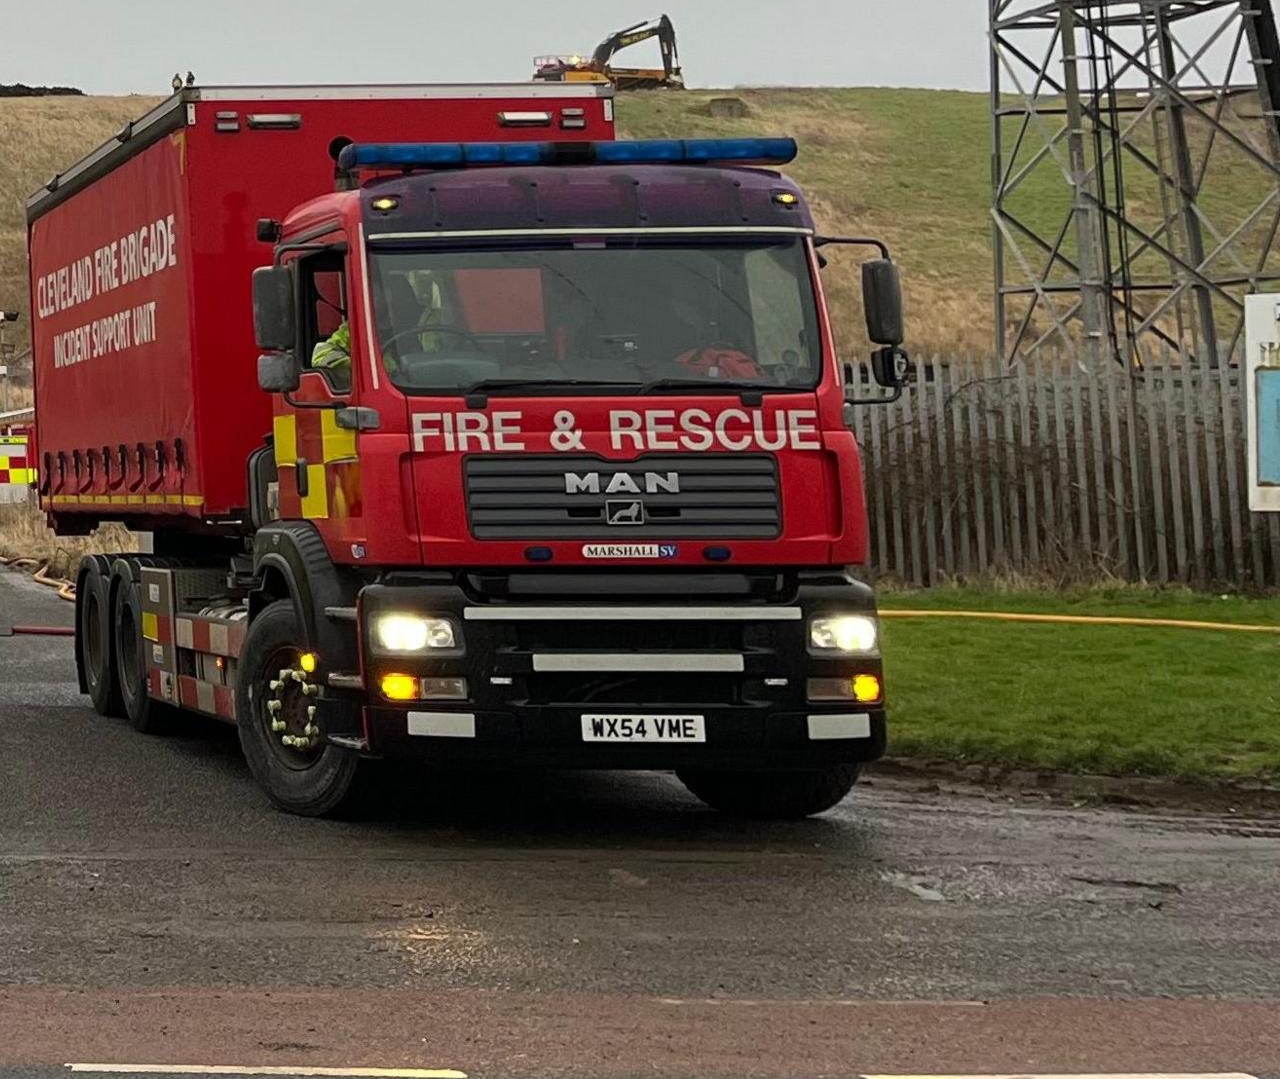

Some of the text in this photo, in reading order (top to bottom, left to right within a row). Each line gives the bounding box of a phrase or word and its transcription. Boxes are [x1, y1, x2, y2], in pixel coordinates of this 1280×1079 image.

[37, 213, 177, 319] CLEVELAND FIRE BRIGADE
[53, 301, 156, 368] INCIDENT SUPPORT UNIT
[412, 409, 821, 452] FIRE & RESCUE
[564, 472, 681, 493] MAN
[587, 546, 676, 557] MARSHALL SV
[591, 718, 696, 738] WX54 VME
